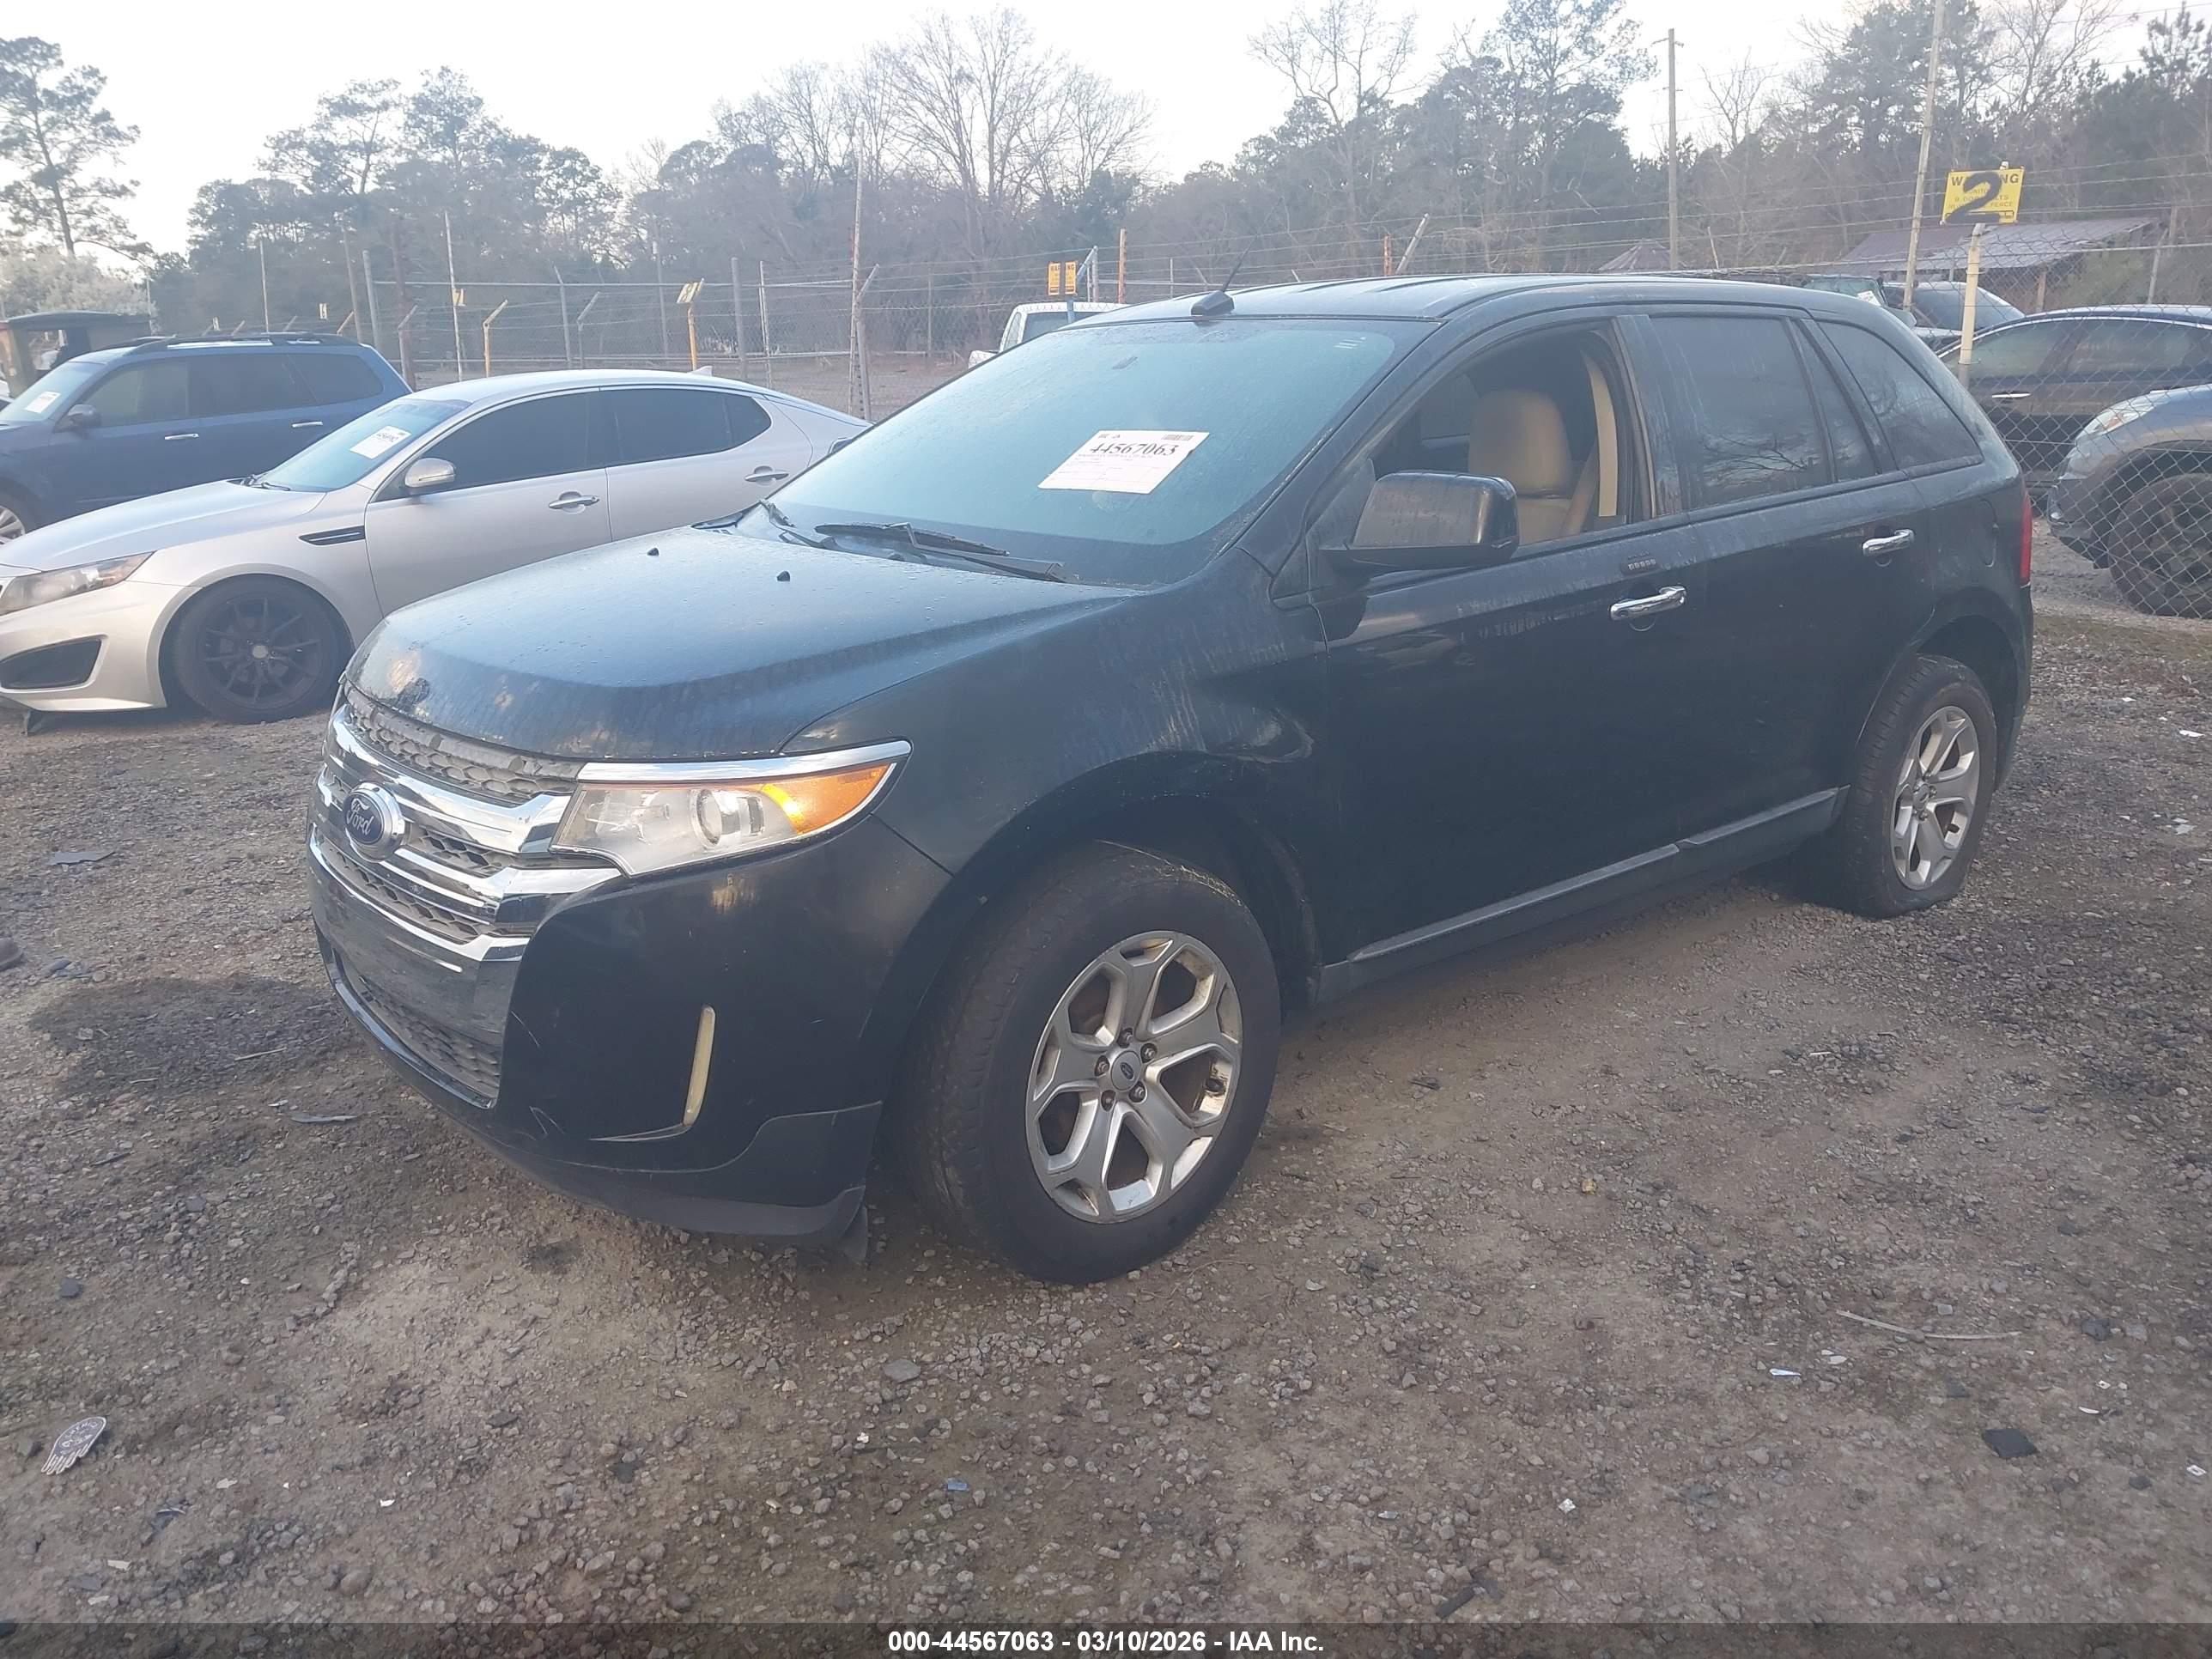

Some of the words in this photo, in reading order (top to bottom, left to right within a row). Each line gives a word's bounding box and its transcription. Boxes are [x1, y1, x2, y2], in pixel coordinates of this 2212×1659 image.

[1944, 171, 2003, 223] 2
[1090, 442, 1180, 455] 44567063
[346, 798, 374, 836] Ford
